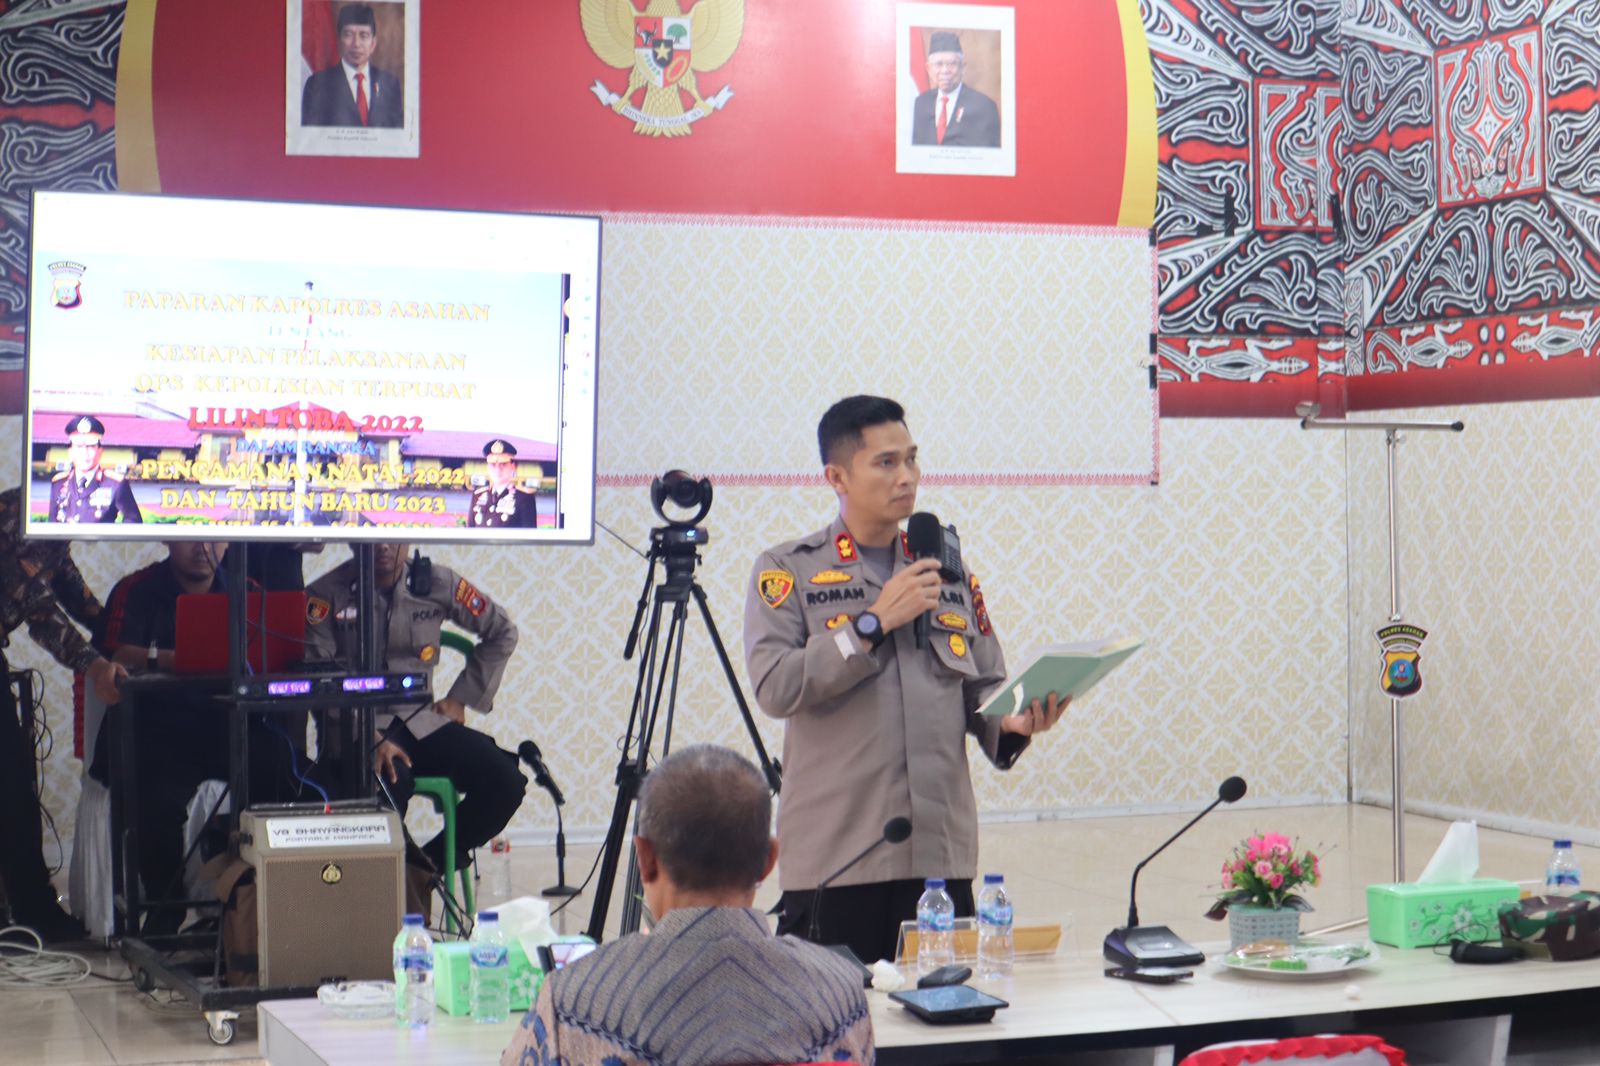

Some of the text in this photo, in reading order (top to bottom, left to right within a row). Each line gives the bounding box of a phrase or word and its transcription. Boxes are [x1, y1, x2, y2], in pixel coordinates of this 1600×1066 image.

[123, 289, 491, 321] PAPARAN KAPOLRES ASAHAN
[146, 343, 467, 371] KESIAPAN PELAKSANAAN
[134, 373, 478, 400] OPS KEPOLISIAN TERPUSAT
[187, 406, 424, 433] LILIN TOBA 2022
[236, 438, 378, 457] DALAM RANGKA
[140, 459, 466, 486] PENGAMANAN NATAL 2022
[160, 487, 447, 515] DAN TAHUN BARU 2023
[805, 587, 866, 606] ROMAN
